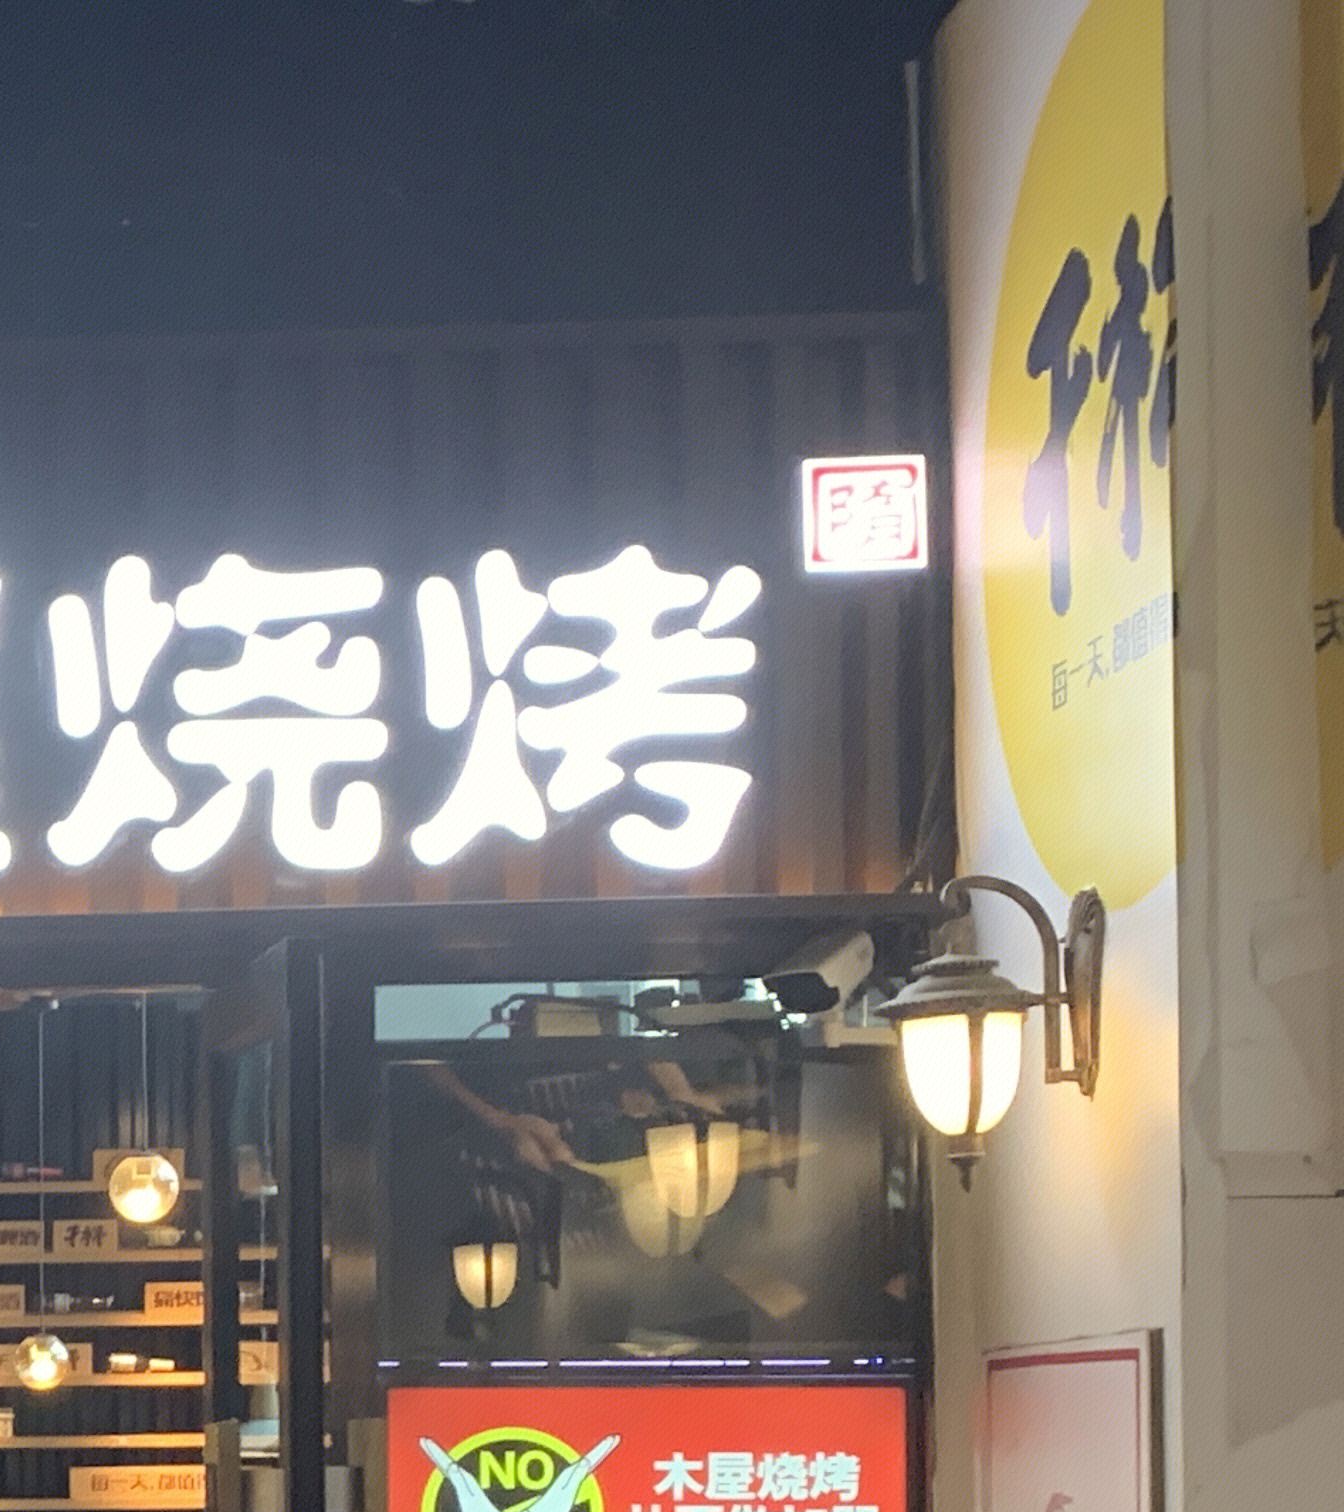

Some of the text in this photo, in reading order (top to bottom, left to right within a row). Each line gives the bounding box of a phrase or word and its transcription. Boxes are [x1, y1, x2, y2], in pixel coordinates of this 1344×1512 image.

[478, 1450, 555, 1490] NO
[652, 1451, 861, 1502] 木屋烧烤
